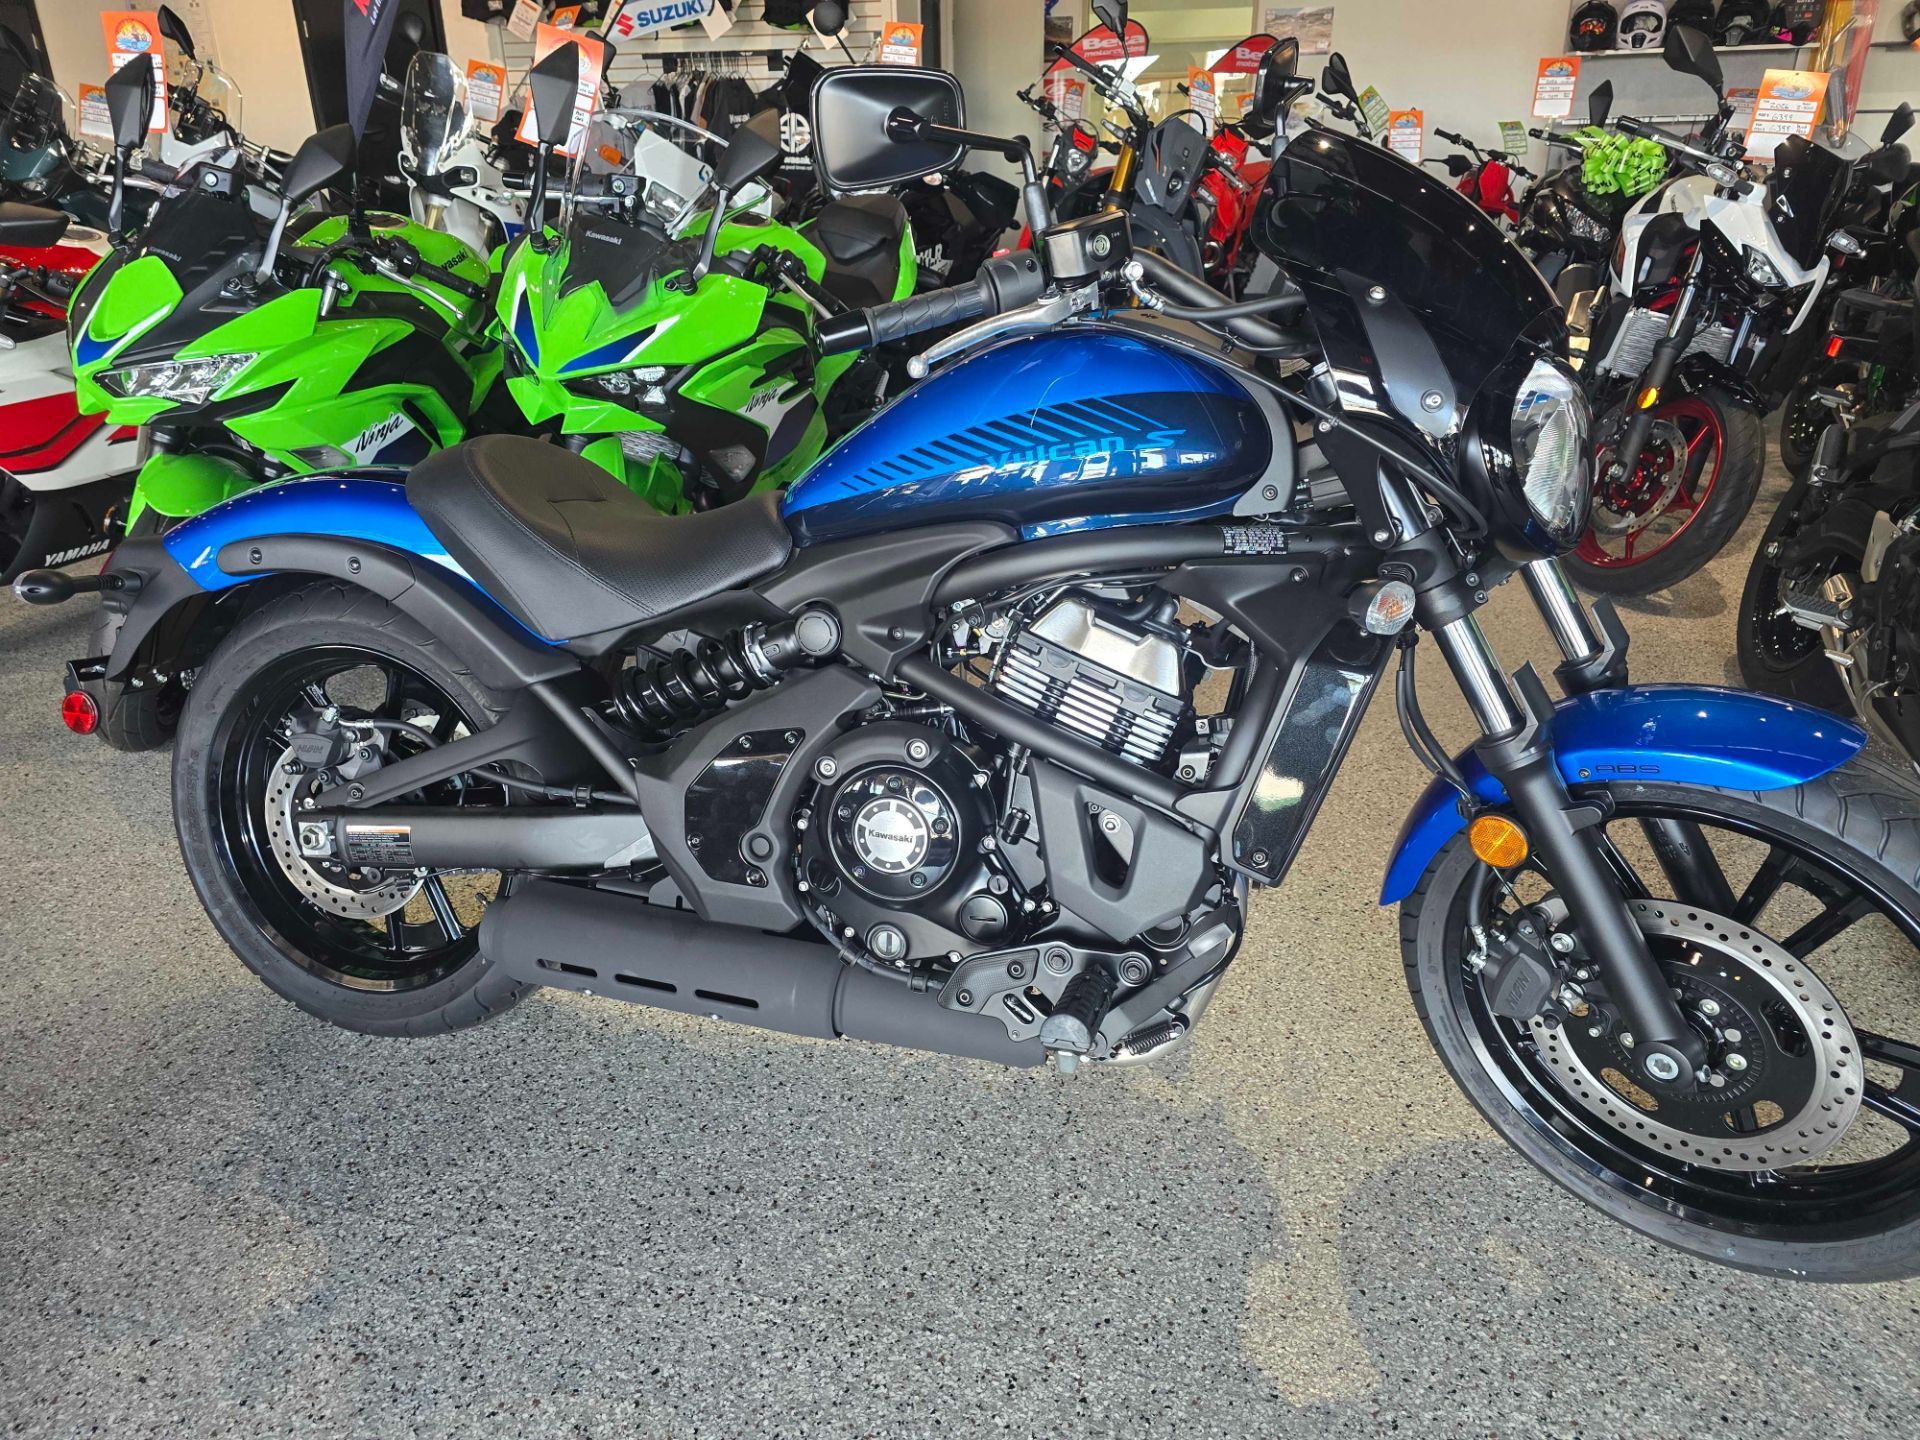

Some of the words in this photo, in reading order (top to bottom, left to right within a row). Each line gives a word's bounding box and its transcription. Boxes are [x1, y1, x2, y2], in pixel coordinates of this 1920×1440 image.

[637, 0, 705, 27] SUZUKI
[585, 230, 622, 245] Kawasaki
[745, 382, 779, 413] Ninja
[355, 413, 403, 453] Ninja
[986, 436, 1125, 469] Vulcan
[1135, 428, 1187, 449] S
[45, 539, 110, 567] YAMAHA
[1595, 764, 1660, 774] ABS
[868, 829, 914, 843] Kawasaki
